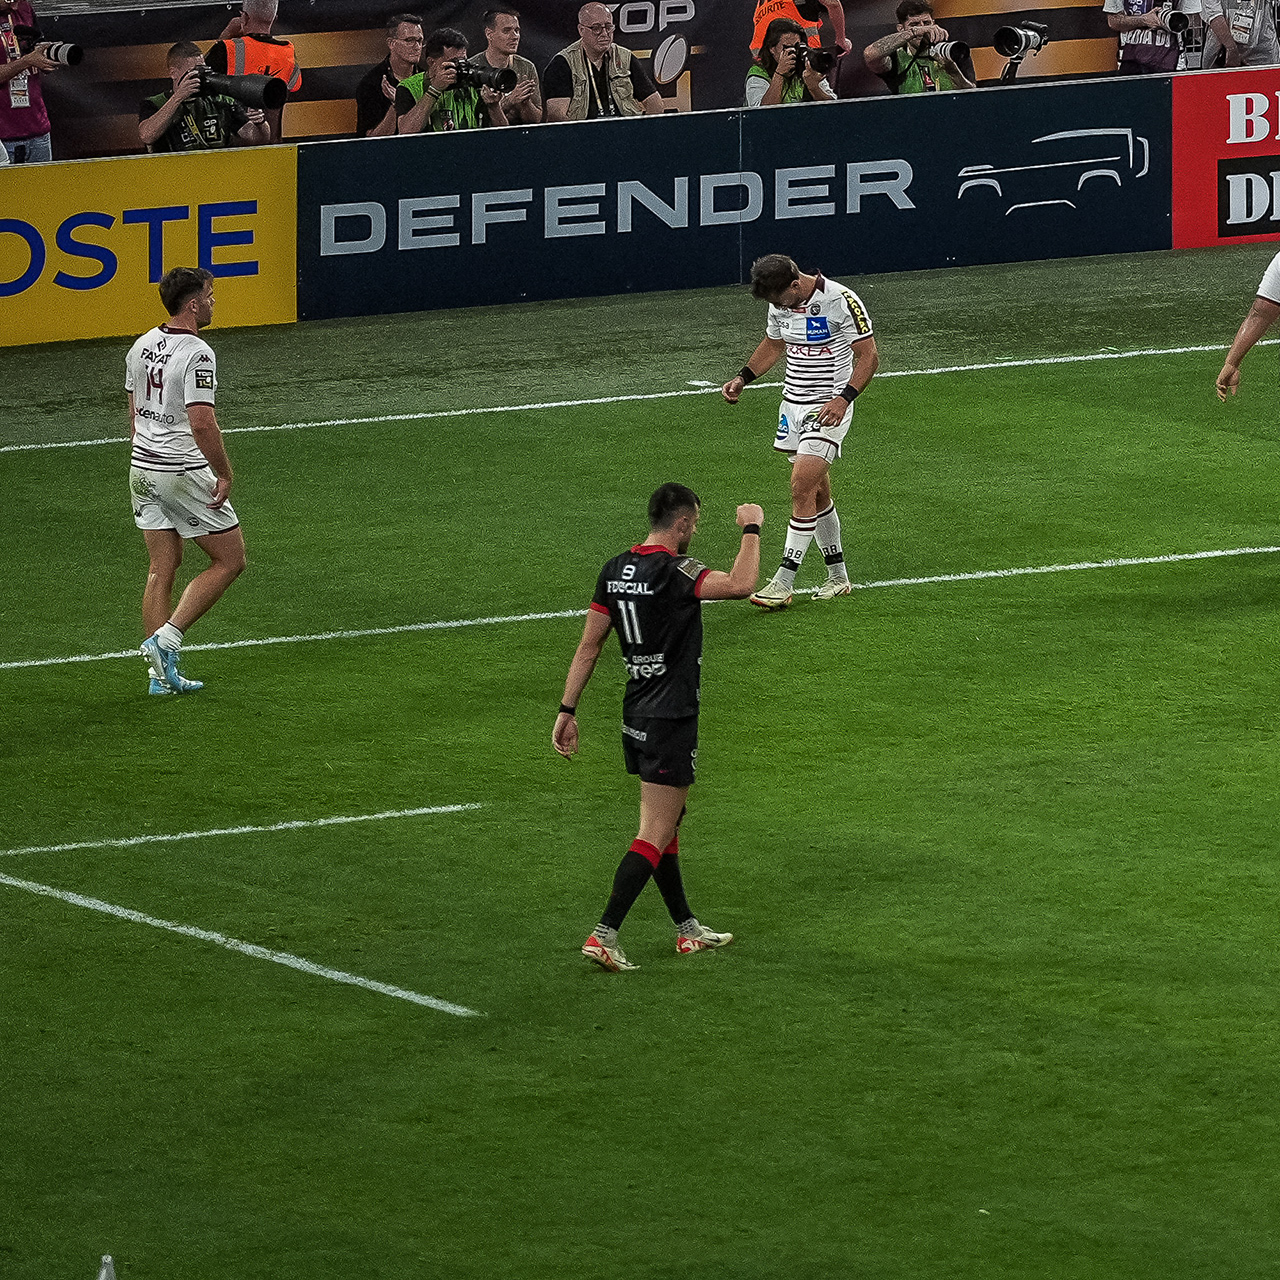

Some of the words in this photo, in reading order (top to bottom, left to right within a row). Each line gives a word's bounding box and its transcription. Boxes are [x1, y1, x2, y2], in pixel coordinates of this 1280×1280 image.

[319, 158, 916, 257] DEFENDER
[140, 347, 173, 365] FAYAT
[144, 364, 164, 405] 14
[616, 599, 644, 645] 11
